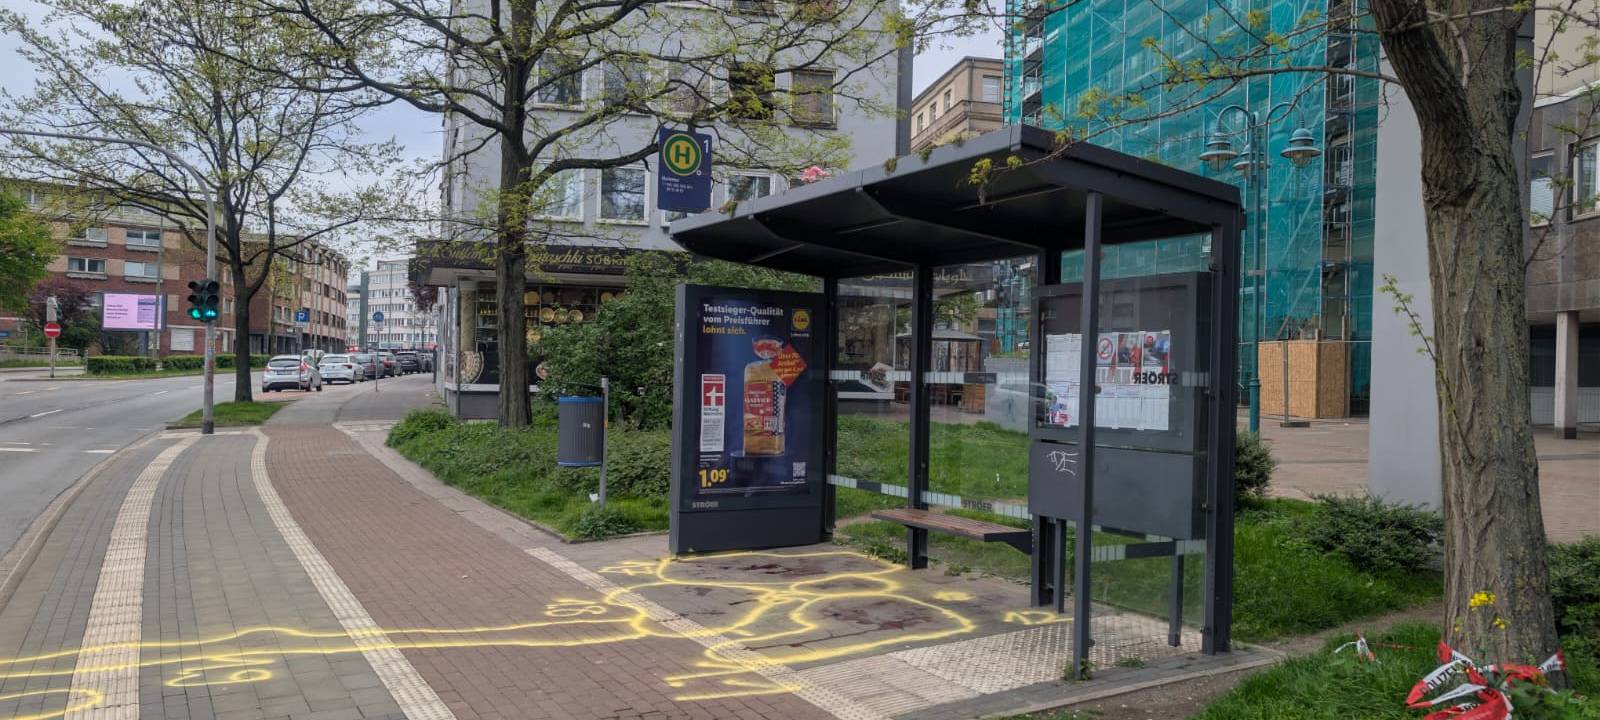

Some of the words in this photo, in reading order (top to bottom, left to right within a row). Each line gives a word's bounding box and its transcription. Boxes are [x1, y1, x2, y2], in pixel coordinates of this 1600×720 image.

[703, 139, 709, 153] 1
[703, 303, 784, 317] Testsieger-Qualität
[703, 315, 722, 324] vom
[723, 315, 770, 326] Preisführer
[703, 325, 725, 335] lohnt
[727, 327, 746, 335] sich.
